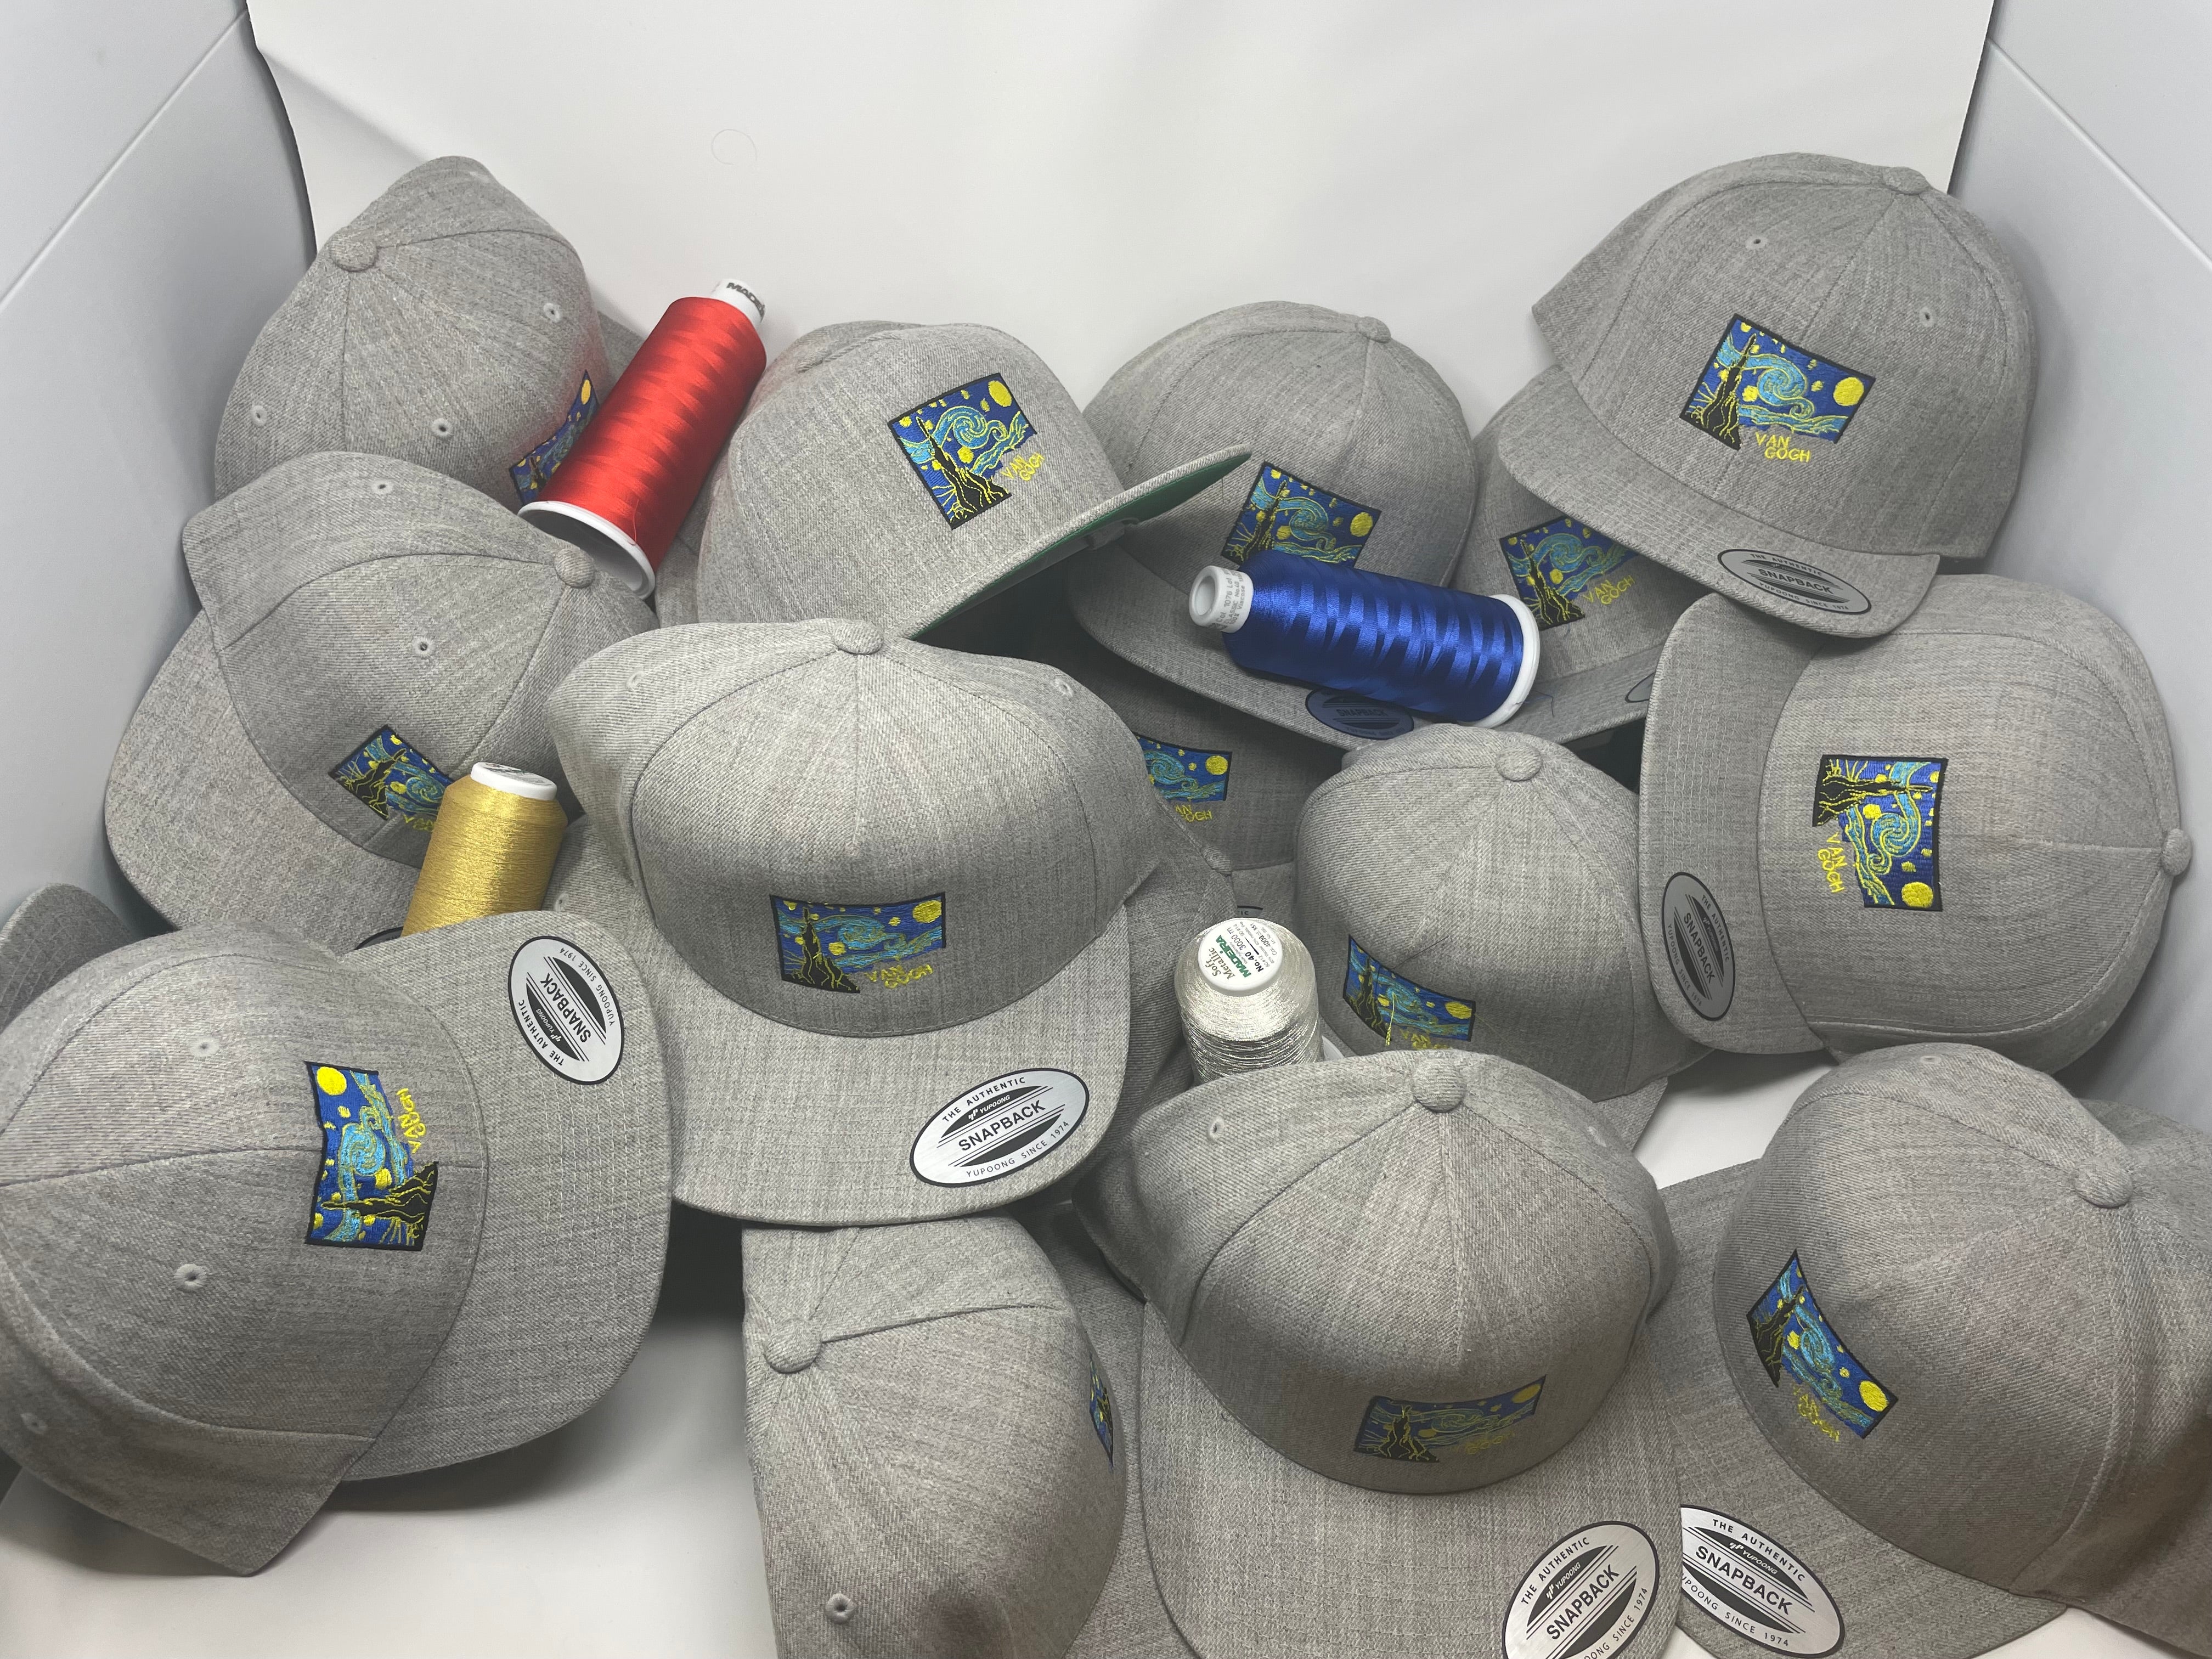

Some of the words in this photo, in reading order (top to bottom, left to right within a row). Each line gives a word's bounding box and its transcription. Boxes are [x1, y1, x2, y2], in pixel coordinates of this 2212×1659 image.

[1756, 432, 1791, 449] VAN
[1000, 455, 1028, 479] VAN
[1764, 447, 1810, 462] GOGH
[1772, 557, 1822, 576] AUTHENTIC
[1582, 580, 1613, 602] VAN
[1758, 568, 1833, 595] SNAPBACK
[1759, 583, 1800, 601] YUPOONG
[1224, 591, 1233, 607] 1076
[1224, 600, 1238, 624] CLASSIC
[1175, 805, 1192, 815] AN
[1181, 809, 1212, 822] OGH
[1826, 831, 1848, 867] VAN
[1818, 849, 1845, 893] GOGH
[1259, 935, 1271, 946] 4000
[1702, 895, 1711, 910] THE
[1711, 913, 1730, 962] AUTHENTIC
[560, 947, 577, 961] 1974
[1232, 935, 1246, 950] 3000
[1684, 912, 1715, 984] SNAPBACK
[1205, 958, 1221, 976] Soft
[1209, 948, 1235, 979] Metallic
[1667, 923, 1679, 966] YUPOONG
[1678, 969, 1691, 991] SINCE
[579, 961, 596, 981] SINCE
[540, 973, 591, 1043] SNAPBACK
[596, 984, 615, 1026] YUPOONG
[518, 999, 548, 1049] AUTHENTIC
[536, 1008, 555, 1036] YUPOONG
[549, 1050, 564, 1066] THE
[942, 1107, 961, 1122] THE
[966, 1076, 1025, 1106] AUTHENTIC
[979, 1094, 1011, 1114] YUPOONG
[398, 1114, 422, 1153] VAN
[958, 1099, 1046, 1152] SNAPBACK
[967, 1158, 1015, 1177] YUPOONG
[1021, 1140, 1048, 1159] SINCE
[1050, 1121, 1069, 1139] 1974
[1712, 1519, 1734, 1533] THE
[1741, 1533, 1805, 1582] AUTHENTIC
[1742, 1550, 1778, 1575] YUPOONG
[1521, 1584, 1537, 1605] THE
[1538, 1537, 1589, 1582] AUTHENTIC
[1555, 1562, 1581, 1589] YUPOONG
[1696, 1545, 1793, 1615] SNAPBACK
[1547, 1564, 1620, 1640] SNAPBACK
[1613, 1615, 1634, 1641] SINCE
[1634, 1588, 1647, 1611] 1974
[1682, 1573, 1718, 1610] UPOONG
[1725, 1612, 1756, 1633] SINCE
[1764, 1632, 1788, 1646] 1974
